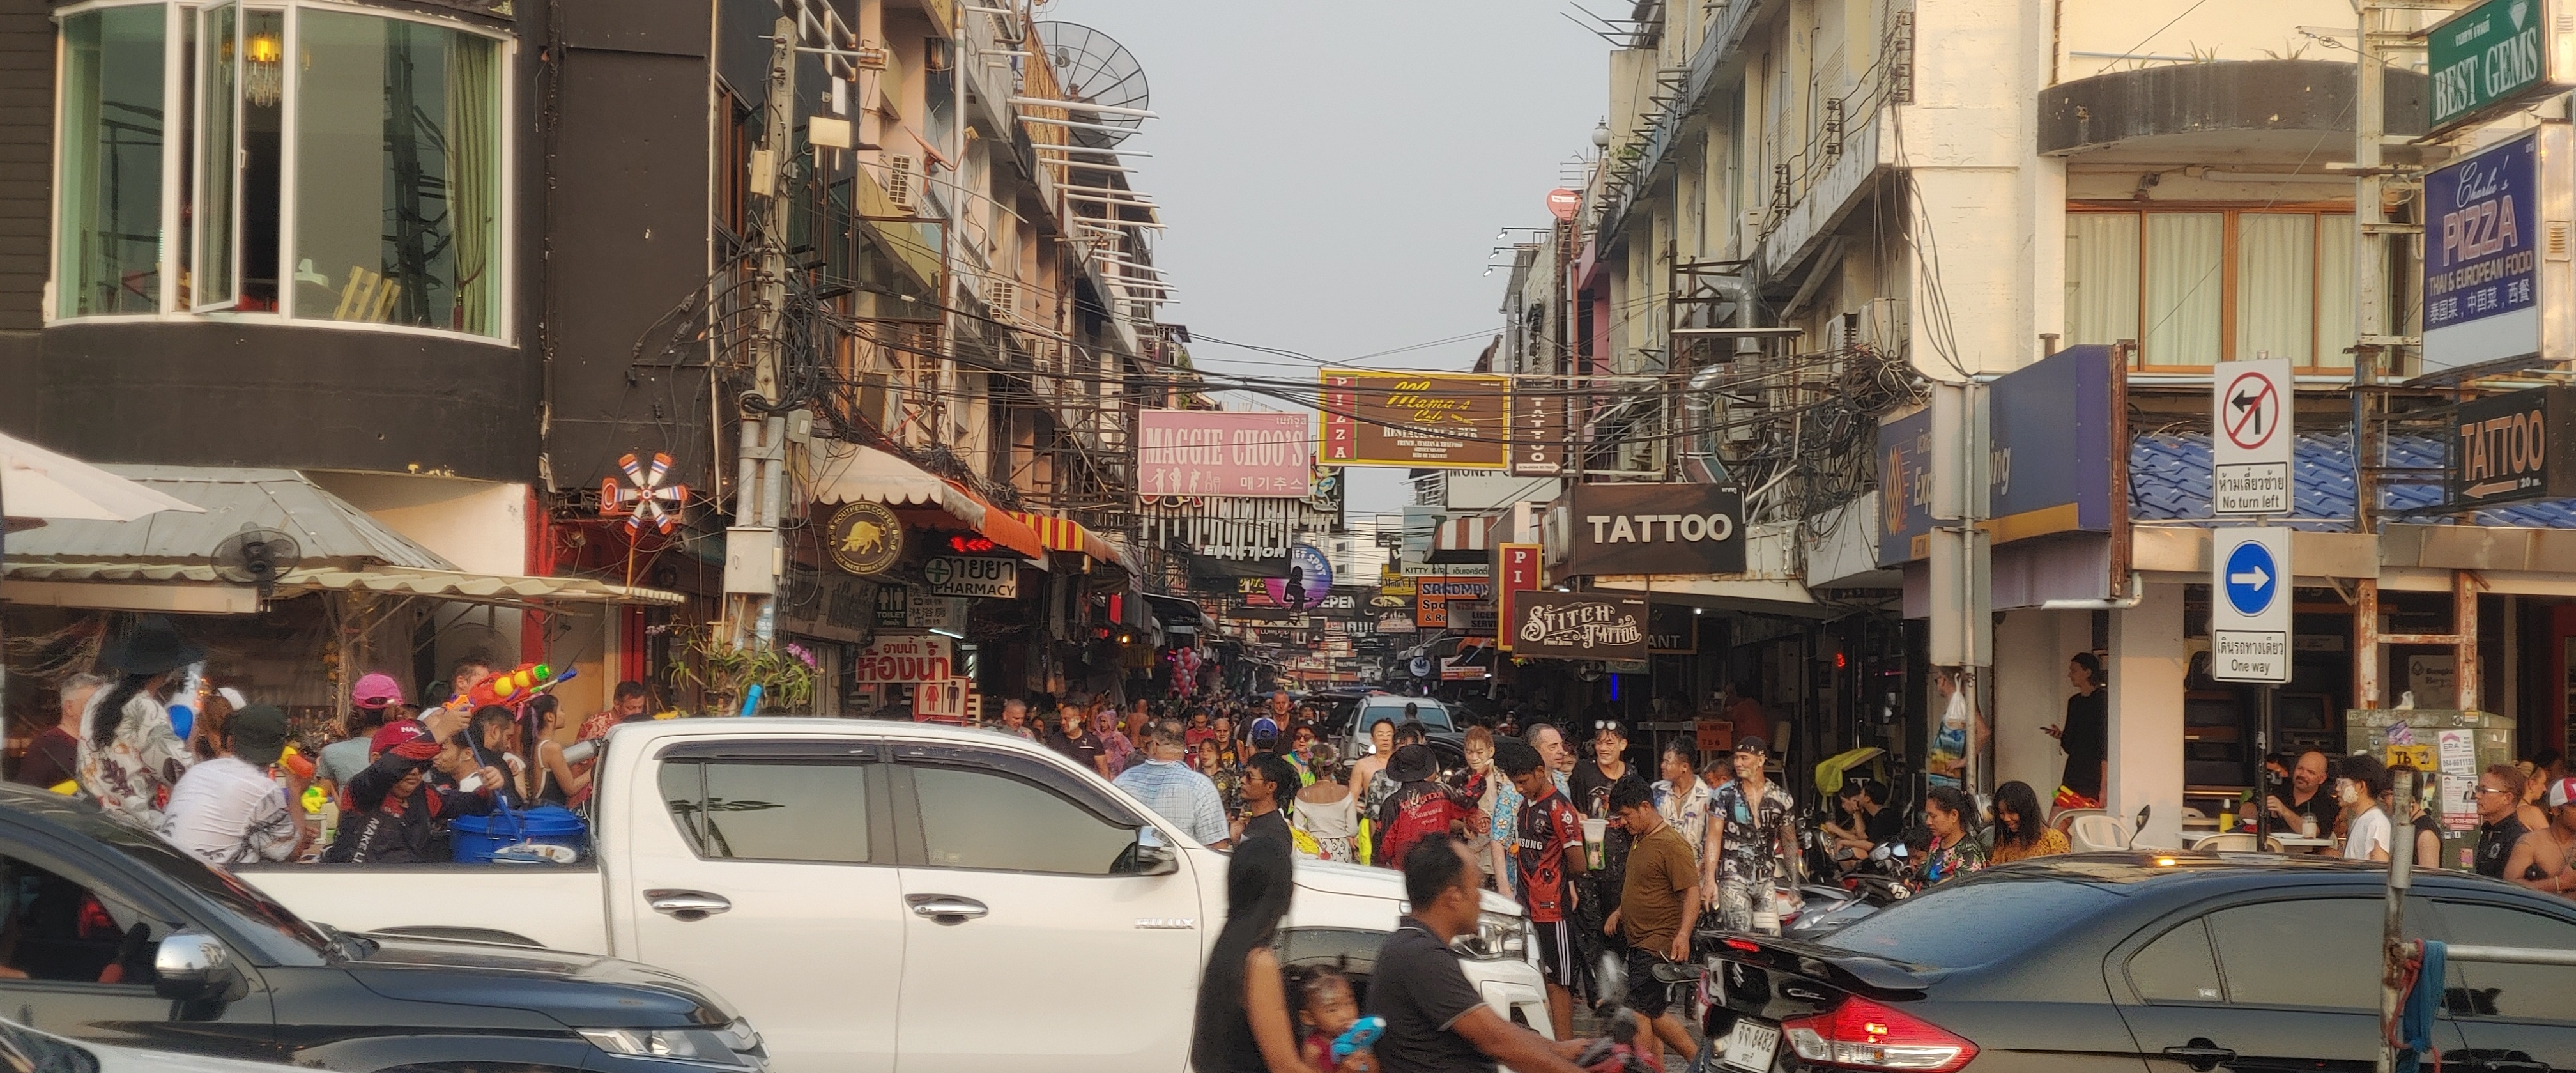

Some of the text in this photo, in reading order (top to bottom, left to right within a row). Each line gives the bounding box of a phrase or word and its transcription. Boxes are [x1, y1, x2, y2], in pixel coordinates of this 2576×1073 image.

[2434, 27, 2538, 120] BEST GEMS
[2457, 154, 2510, 208] Charlie's
[2442, 194, 2518, 266] PIZZA
[2429, 250, 2533, 297] THAI & EUROPEAN FOOD
[1335, 378, 1347, 458] PIZZA
[1531, 398, 1545, 461] TATTOO
[1145, 428, 1304, 467] MAGGIE CHOO'S
[2461, 409, 2545, 481] TATTOO
[1240, 476, 1303, 491] 매기추스
[2219, 467, 2284, 491] ห้ามเลี้ยวซ้าย
[2520, 477, 2531, 488] 20
[2223, 494, 2279, 509] No turn left
[834, 504, 895, 529] SOUTHERN COFFEE
[1586, 513, 1733, 543] TATTOO
[844, 559, 860, 571] TASTE
[949, 558, 1014, 582] ายยา
[1307, 553, 1326, 575] SPOT
[935, 583, 1015, 596] PHARMACY
[1521, 605, 1611, 642] STITCH
[1582, 620, 1643, 649] TATTOO
[883, 637, 918, 654] อาบน้ำ
[2217, 637, 2283, 656] เดินรถทางเดียว
[857, 641, 949, 681] ห้องน้ำ
[2231, 658, 2270, 675] One way
[357, 817, 380, 851] MAKE
[1134, 918, 1195, 929] HILUX
